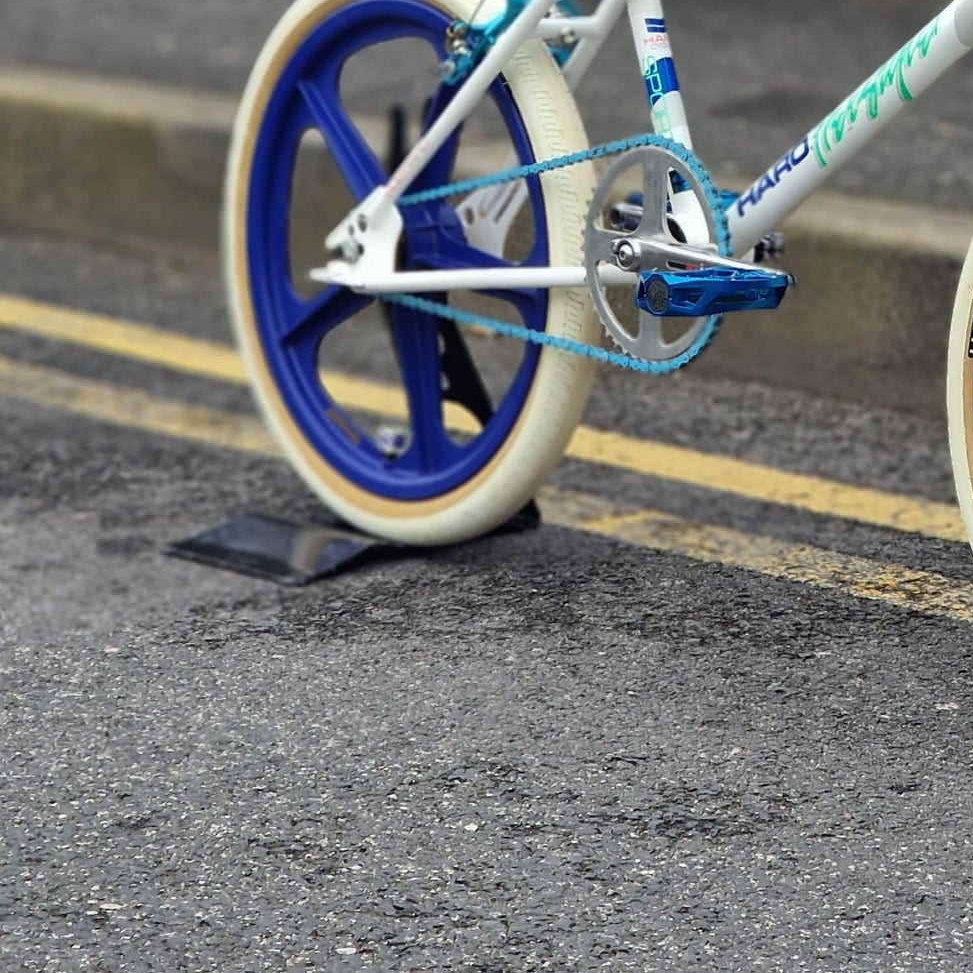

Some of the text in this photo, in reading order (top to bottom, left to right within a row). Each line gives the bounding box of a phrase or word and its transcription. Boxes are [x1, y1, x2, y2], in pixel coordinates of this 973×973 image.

[643, 33, 671, 47] HAR
[642, 55, 673, 139] SPOR
[736, 137, 812, 217] HARO
